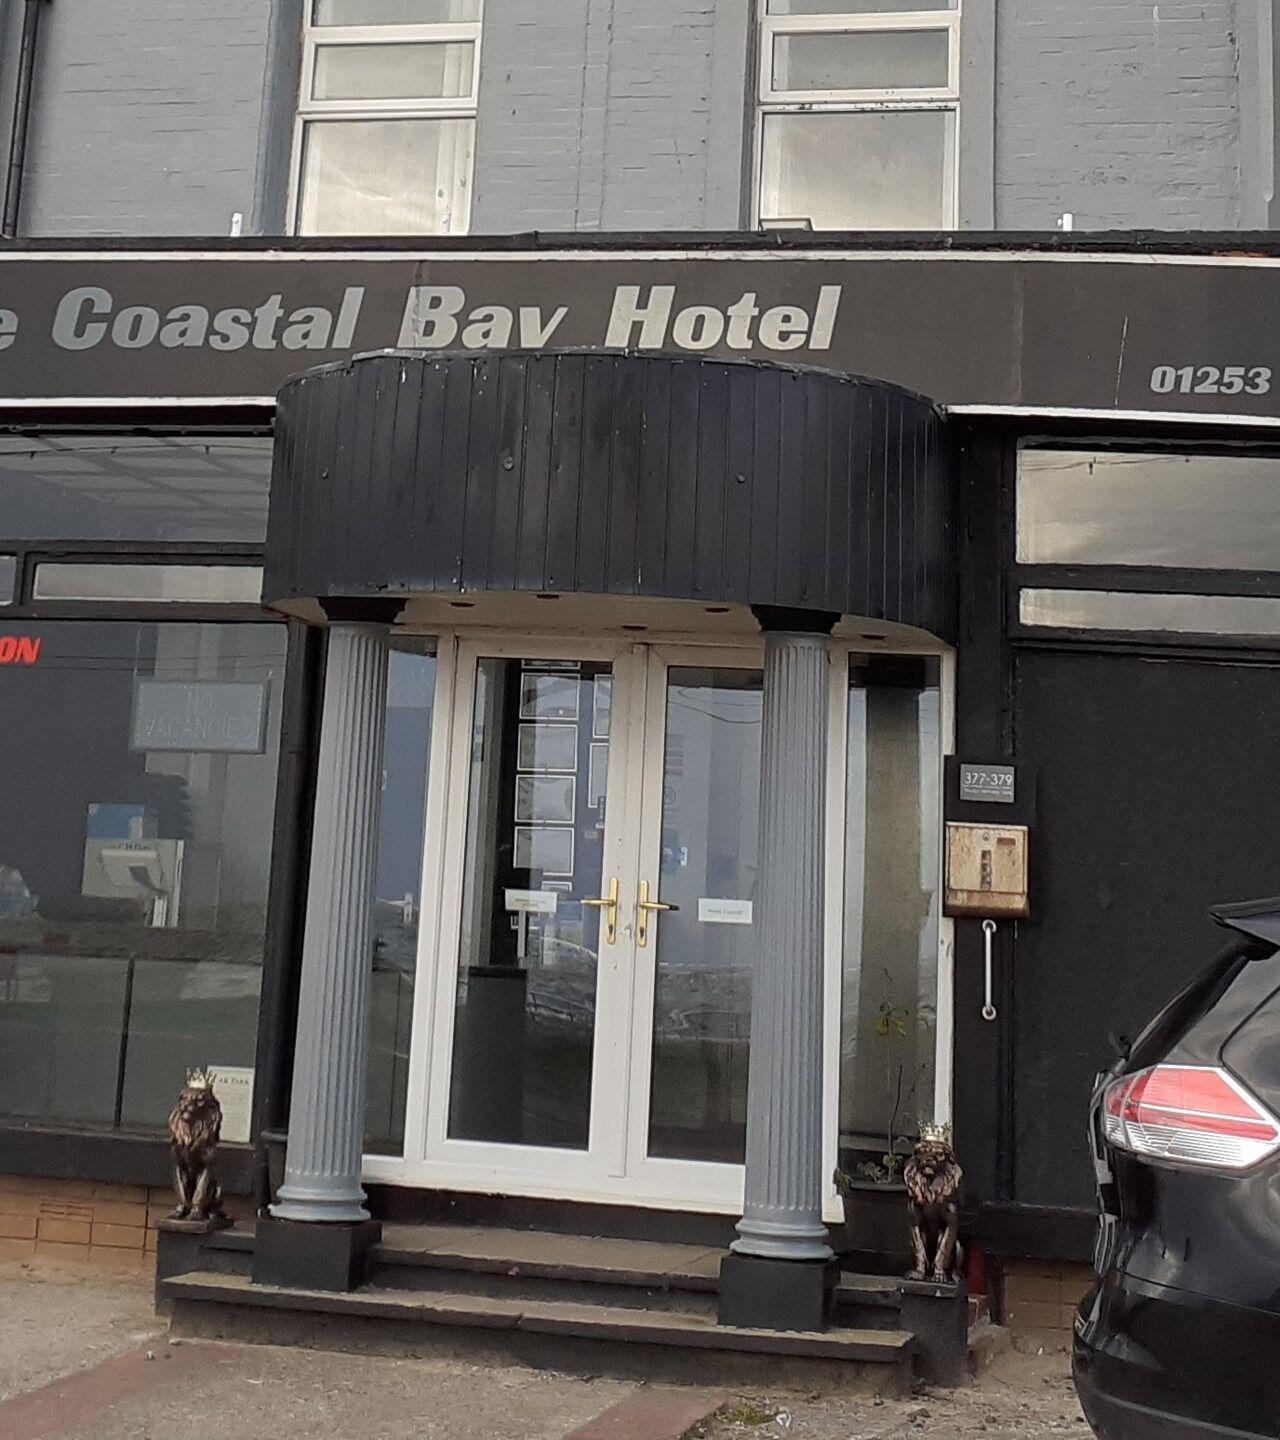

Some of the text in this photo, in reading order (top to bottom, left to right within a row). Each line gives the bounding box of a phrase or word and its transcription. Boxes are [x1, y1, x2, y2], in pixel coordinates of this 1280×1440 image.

[51, 286, 365, 351] Coastal
[604, 285, 842, 350] Hotel
[1150, 366, 1272, 394] 01253
